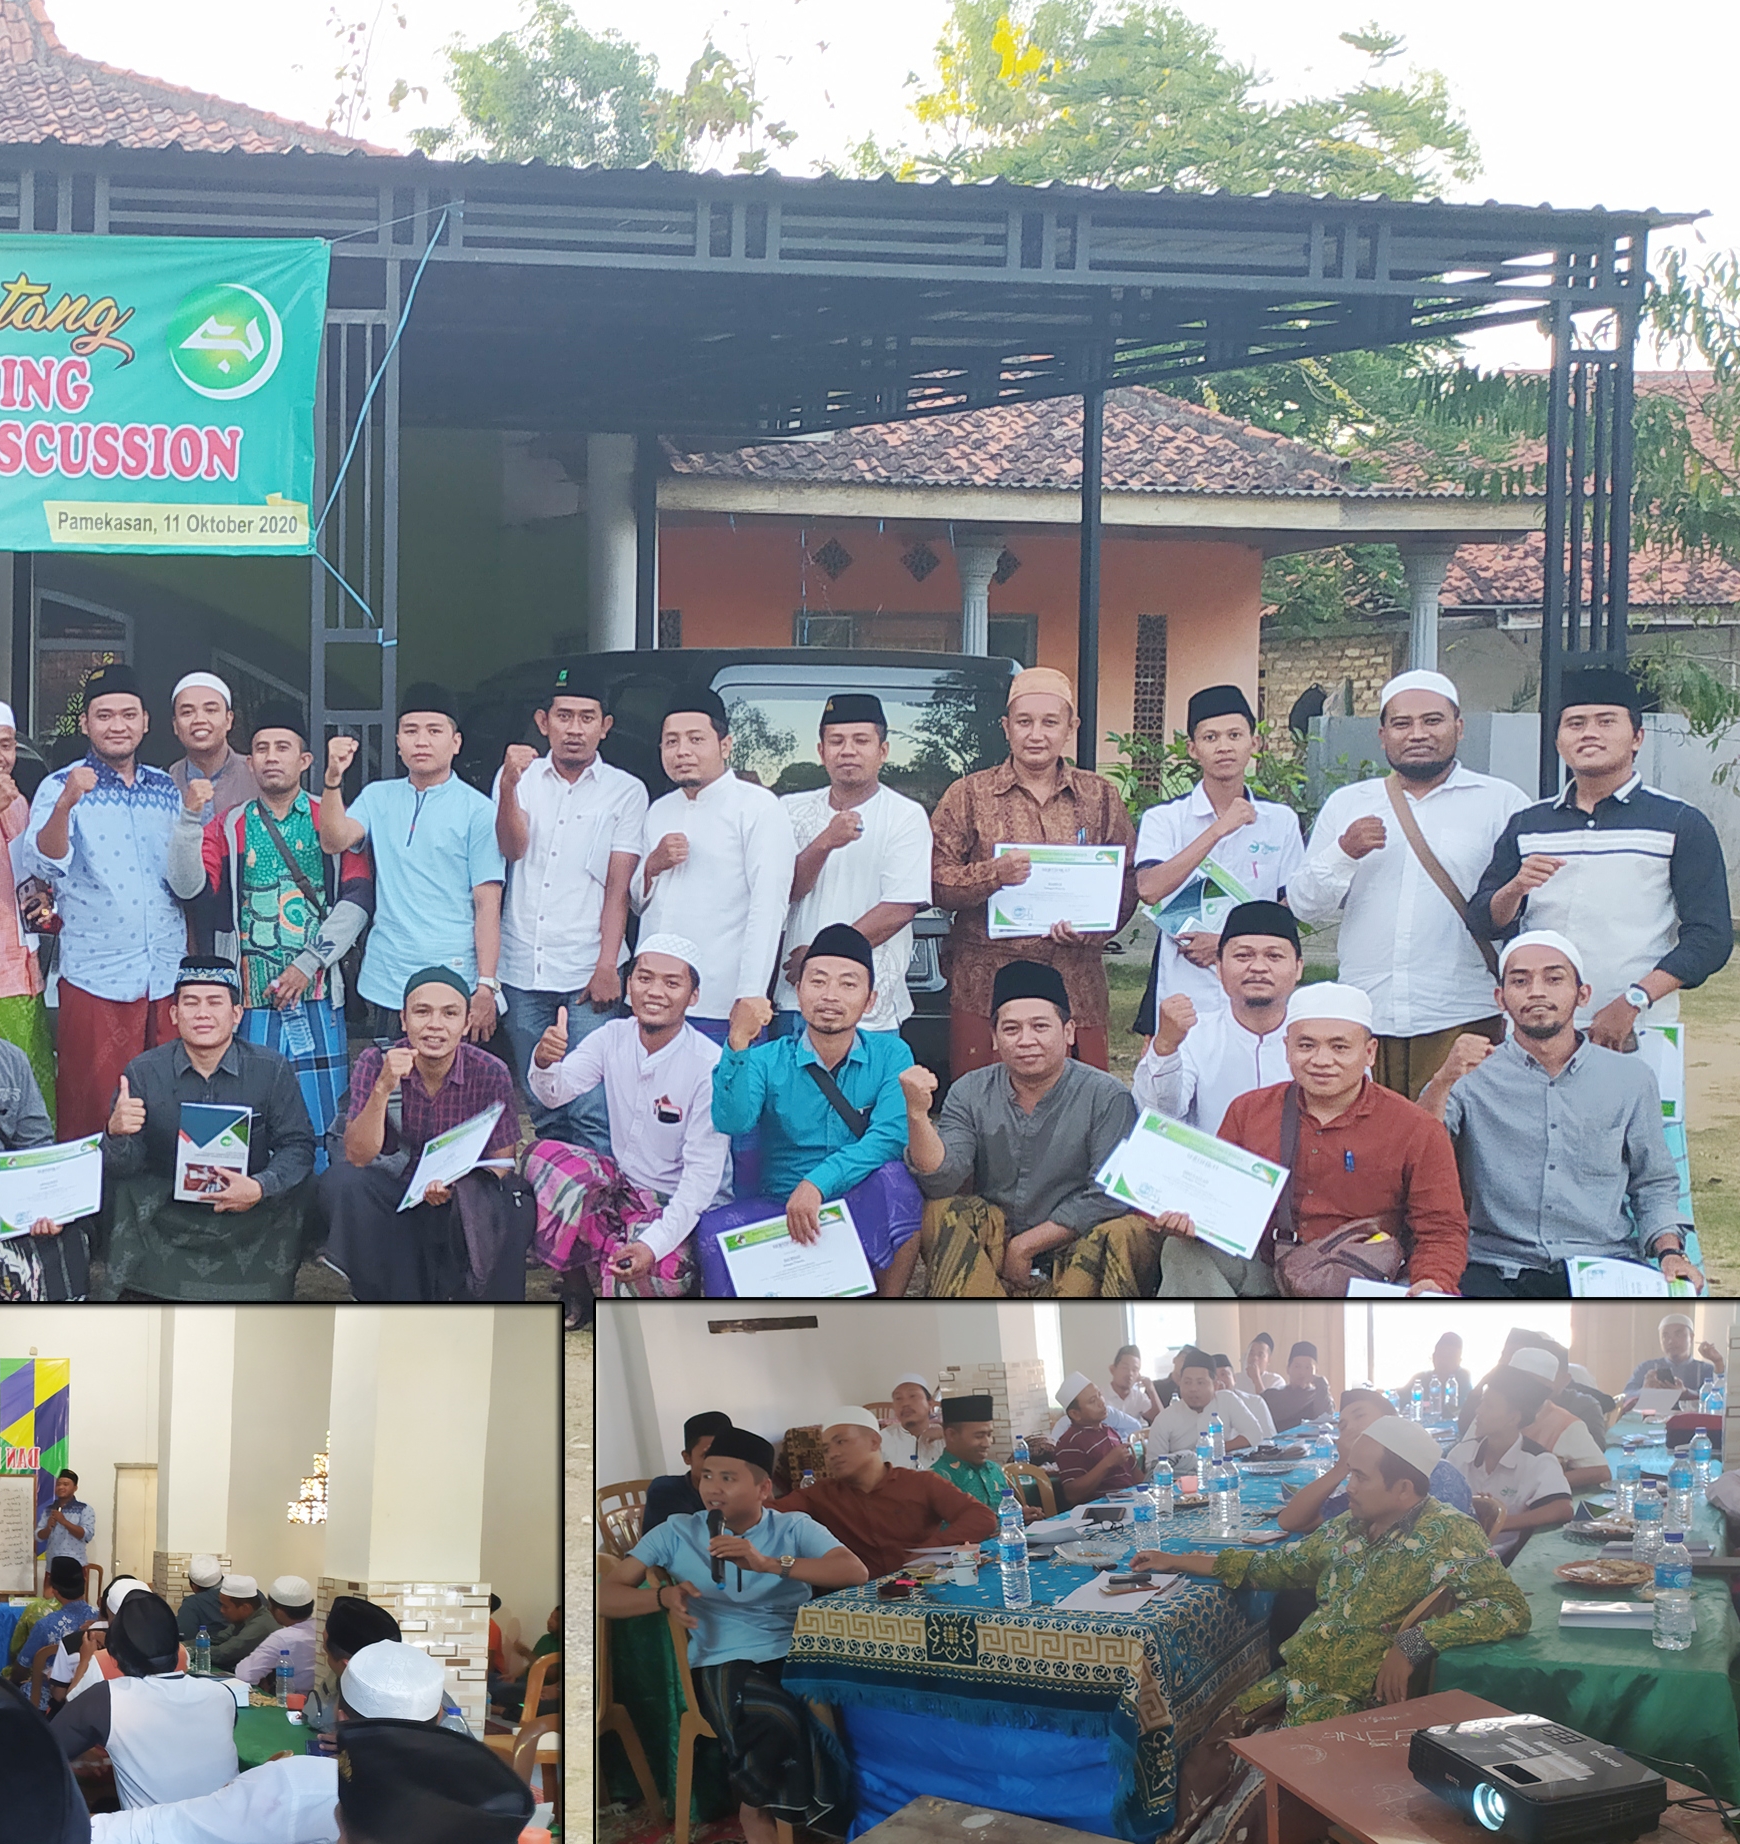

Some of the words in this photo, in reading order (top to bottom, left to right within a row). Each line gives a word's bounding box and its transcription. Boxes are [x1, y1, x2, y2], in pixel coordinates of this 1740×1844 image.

[57, 511, 157, 535] Pamekasan,
[163, 514, 179, 532] 11
[186, 514, 254, 534] Oktober
[258, 515, 298, 534] 2020
